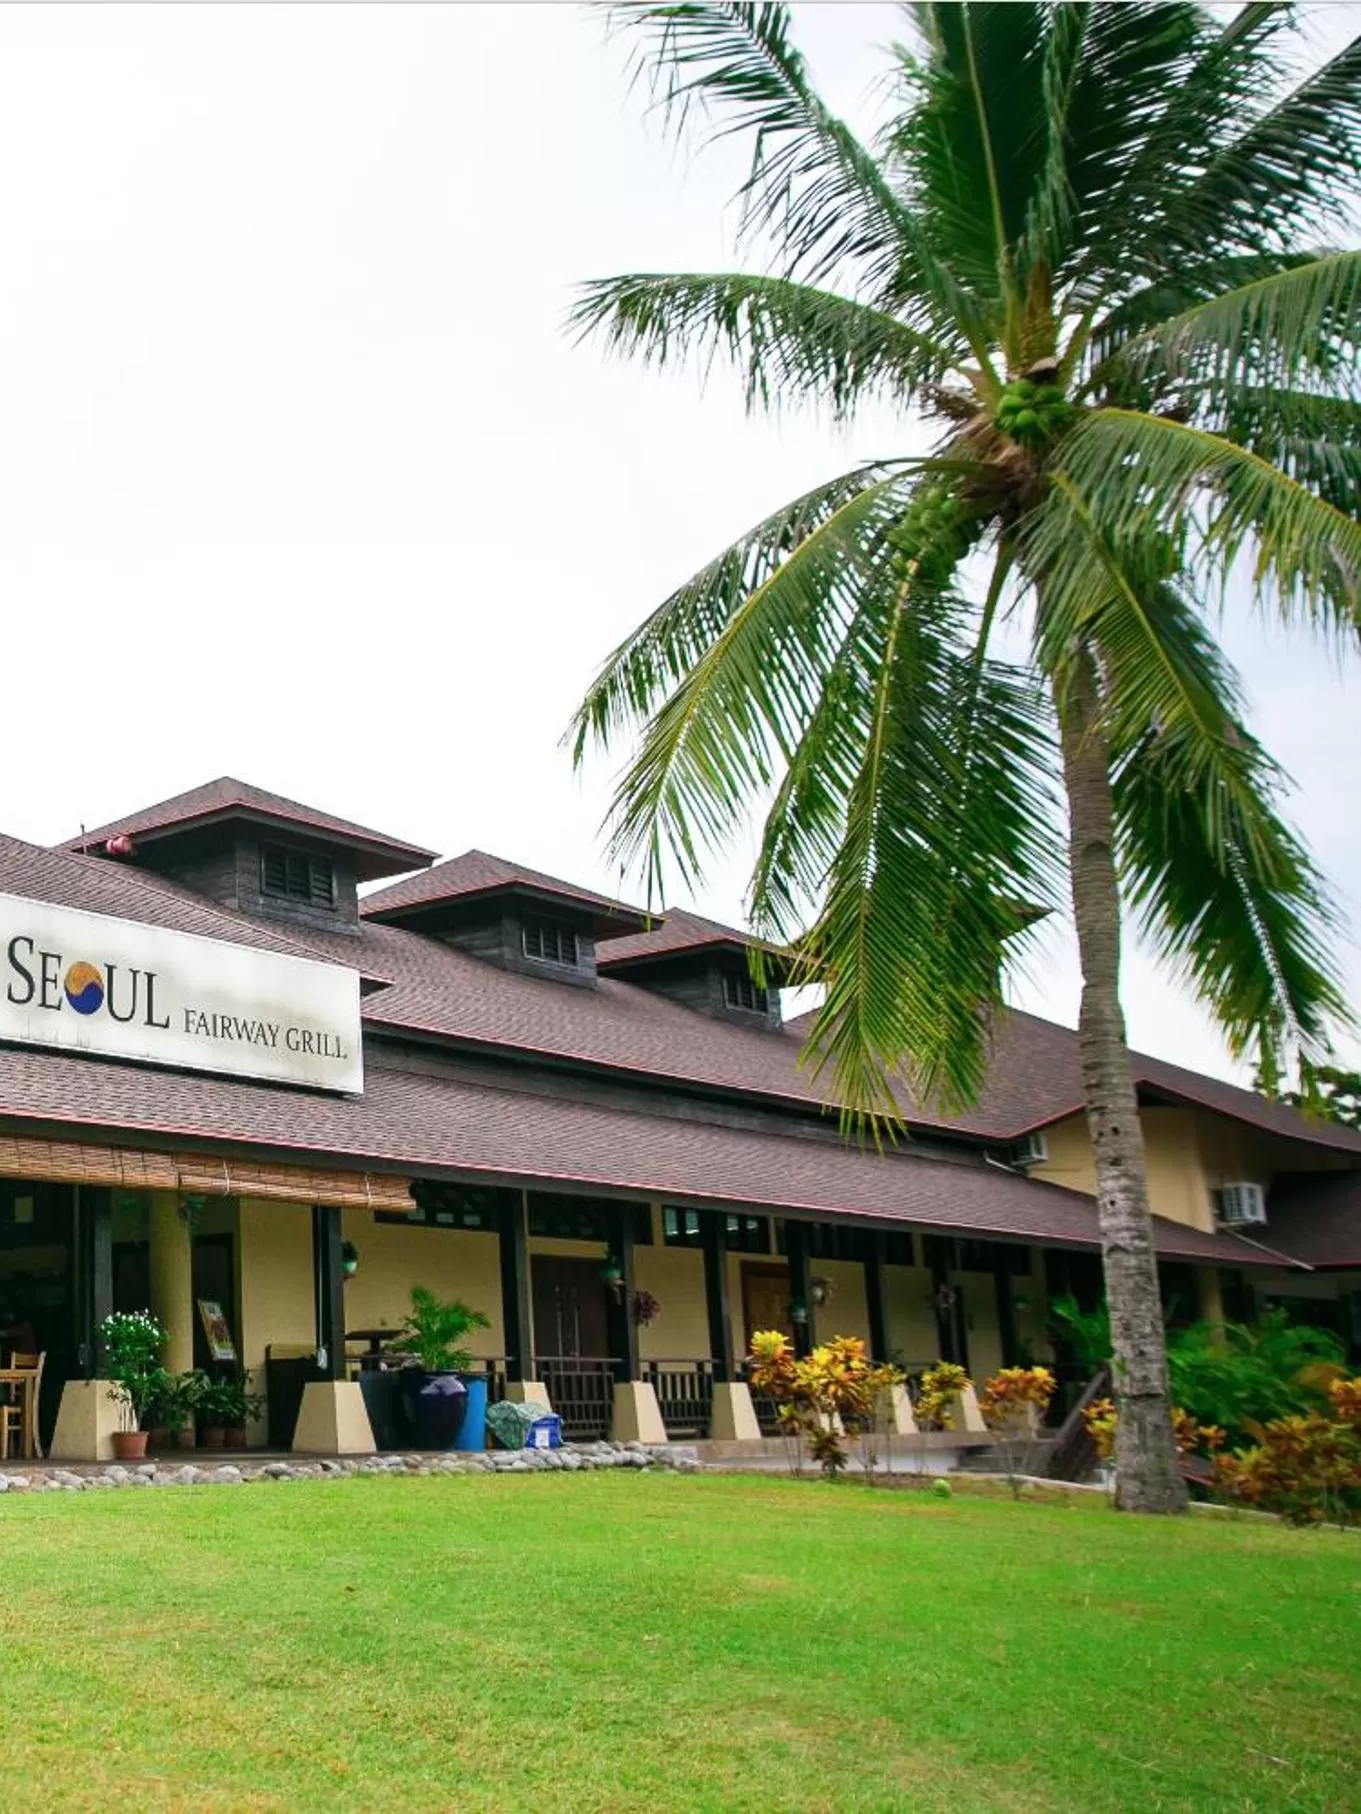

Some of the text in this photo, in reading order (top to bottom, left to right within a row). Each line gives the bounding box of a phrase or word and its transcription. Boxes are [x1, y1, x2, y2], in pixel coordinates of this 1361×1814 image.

[7, 936, 348, 1059] SEOUL FAIRWAY GRILL
